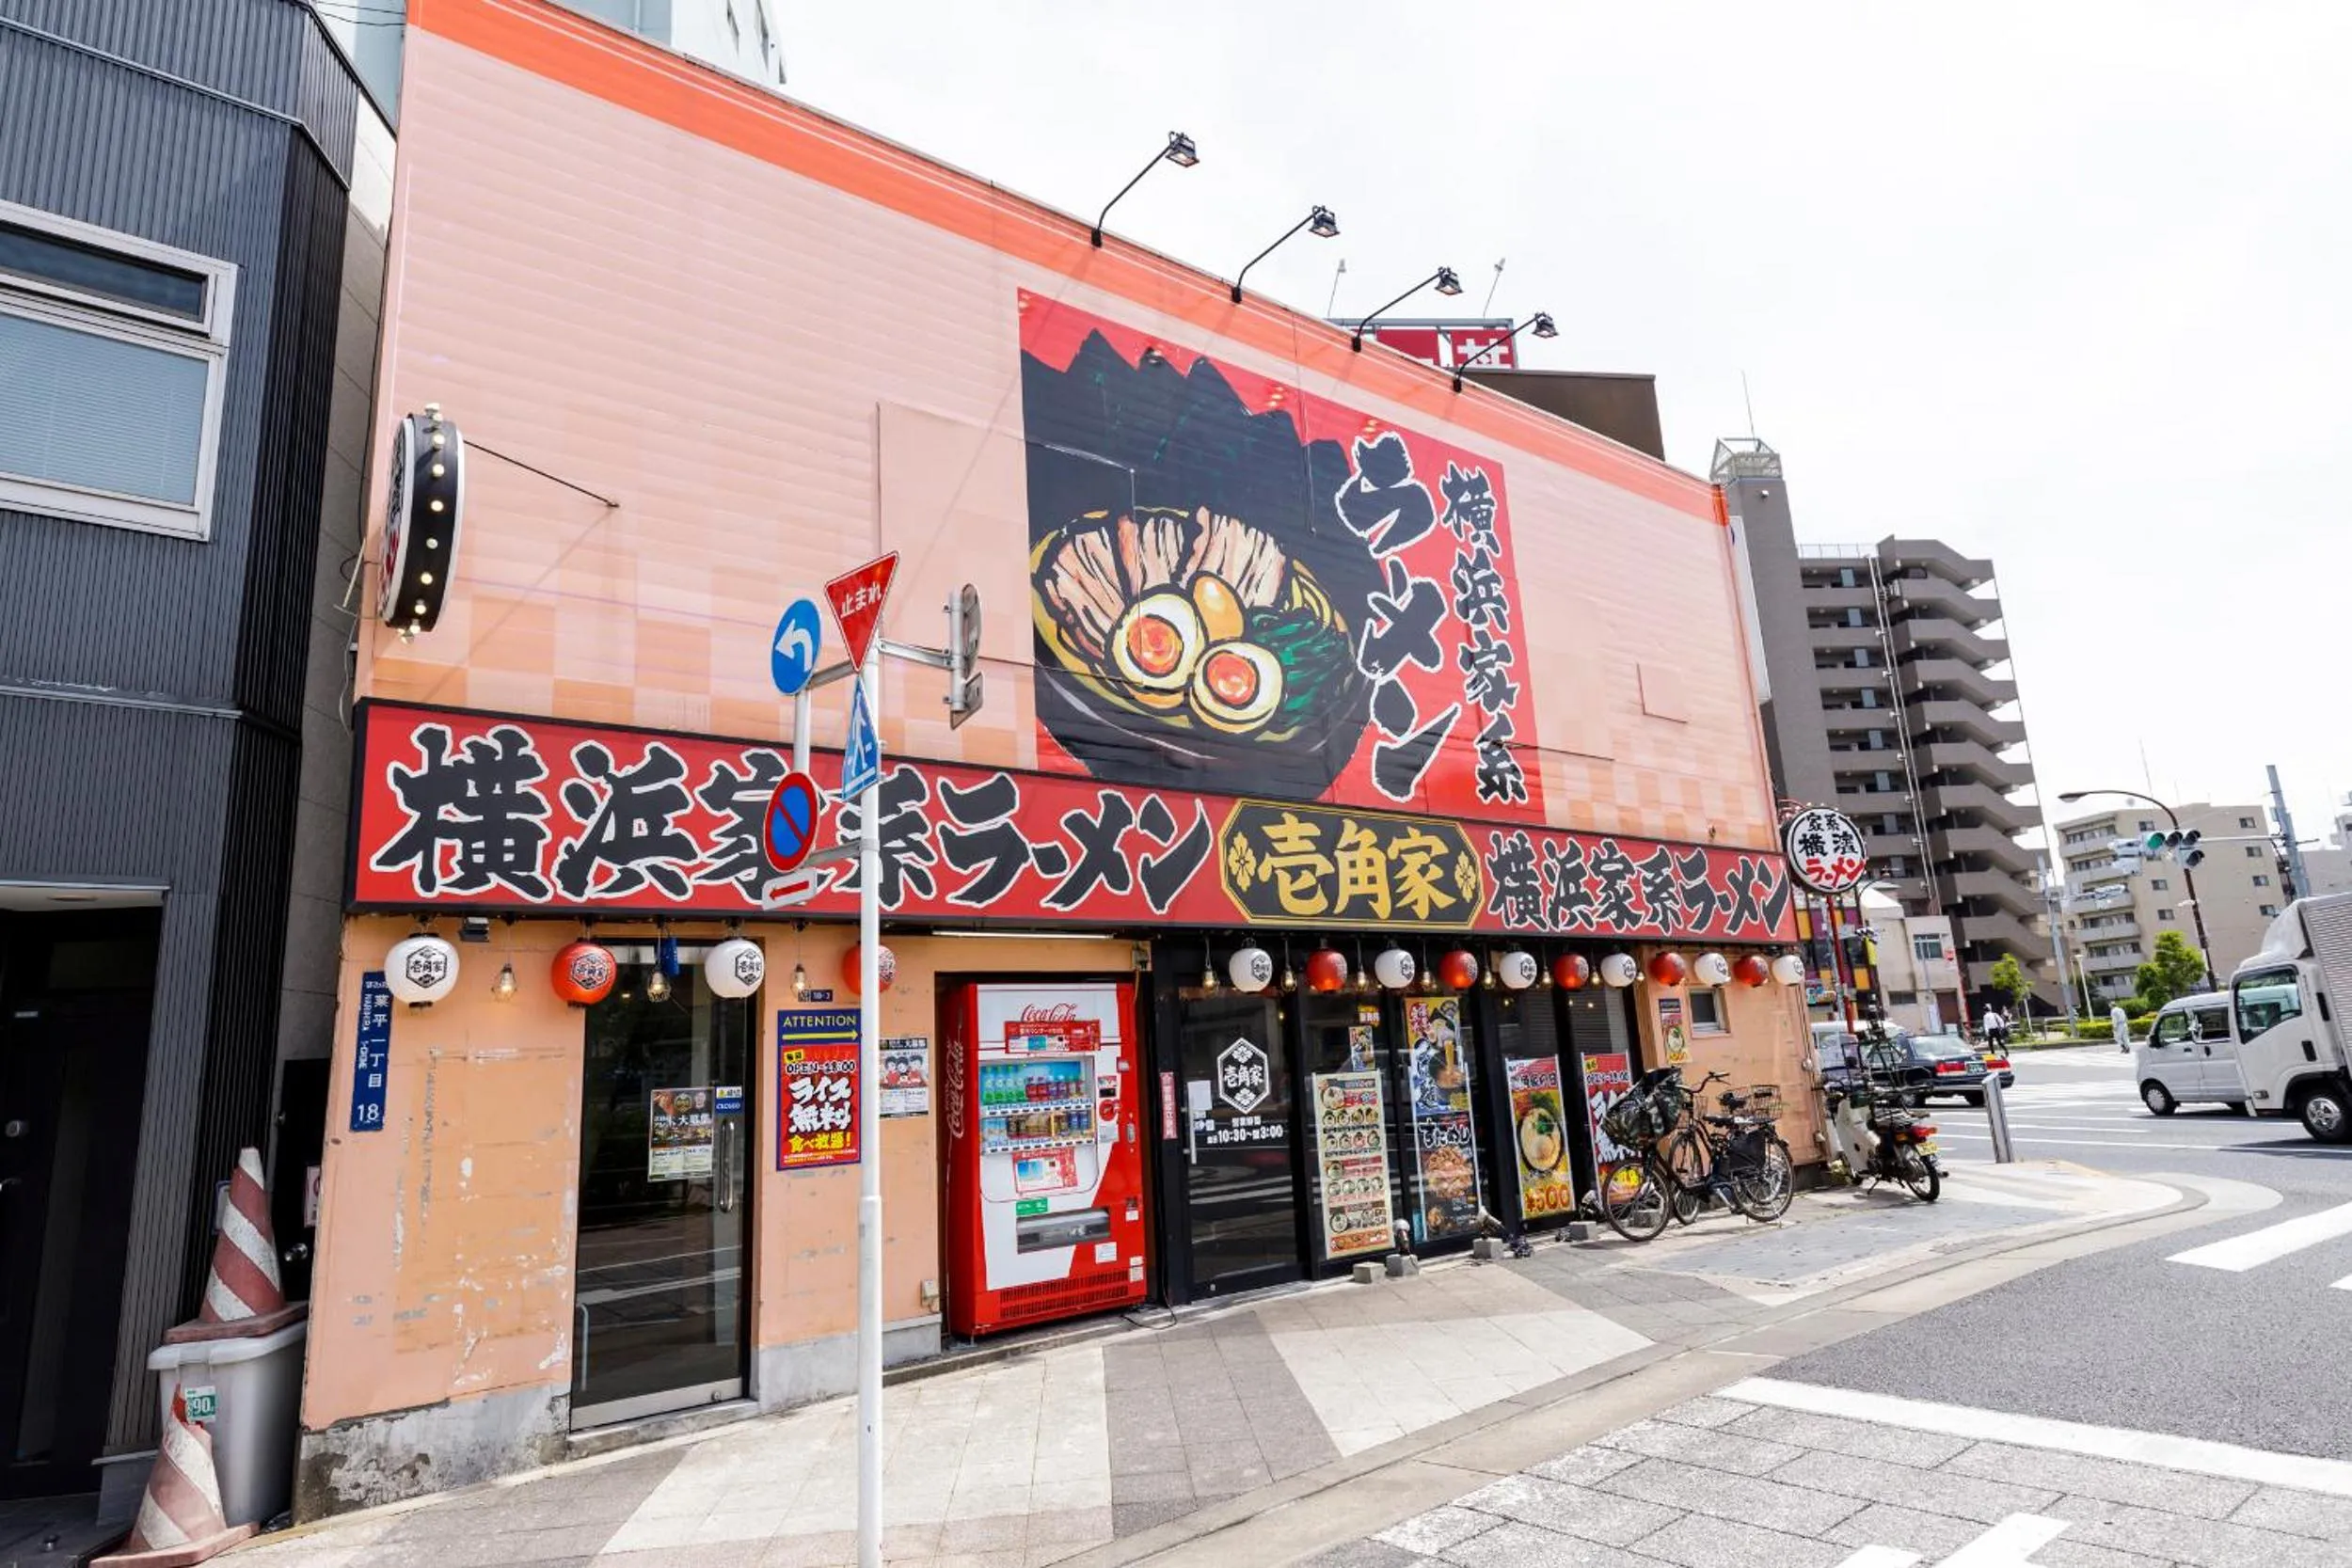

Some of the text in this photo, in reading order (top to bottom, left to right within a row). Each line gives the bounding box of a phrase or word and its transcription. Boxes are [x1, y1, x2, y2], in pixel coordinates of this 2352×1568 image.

[840, 581, 882, 618] 止まれ
[1334, 430, 1462, 802] ラーメン
[1438, 460, 1528, 806] 横浜家系
[1806, 812, 1840, 832] 家系
[1257, 811, 1463, 920] 壱角家
[1805, 856, 1866, 888] ラーメン
[1485, 830, 1788, 939] 横浜家系ラーメン
[410, 959, 444, 974] 壱角家
[783, 1015, 857, 1028] ATTENTION
[368, 993, 389, 1088] 業平一丁目
[788, 1076, 852, 1105] ライス
[1224, 1064, 1263, 1088] 壱角家
[357, 1102, 380, 1122] 18
[788, 1101, 852, 1133] 無料
[1525, 1183, 1571, 1212] ¥500
[192, 1396, 212, 1415] 90
